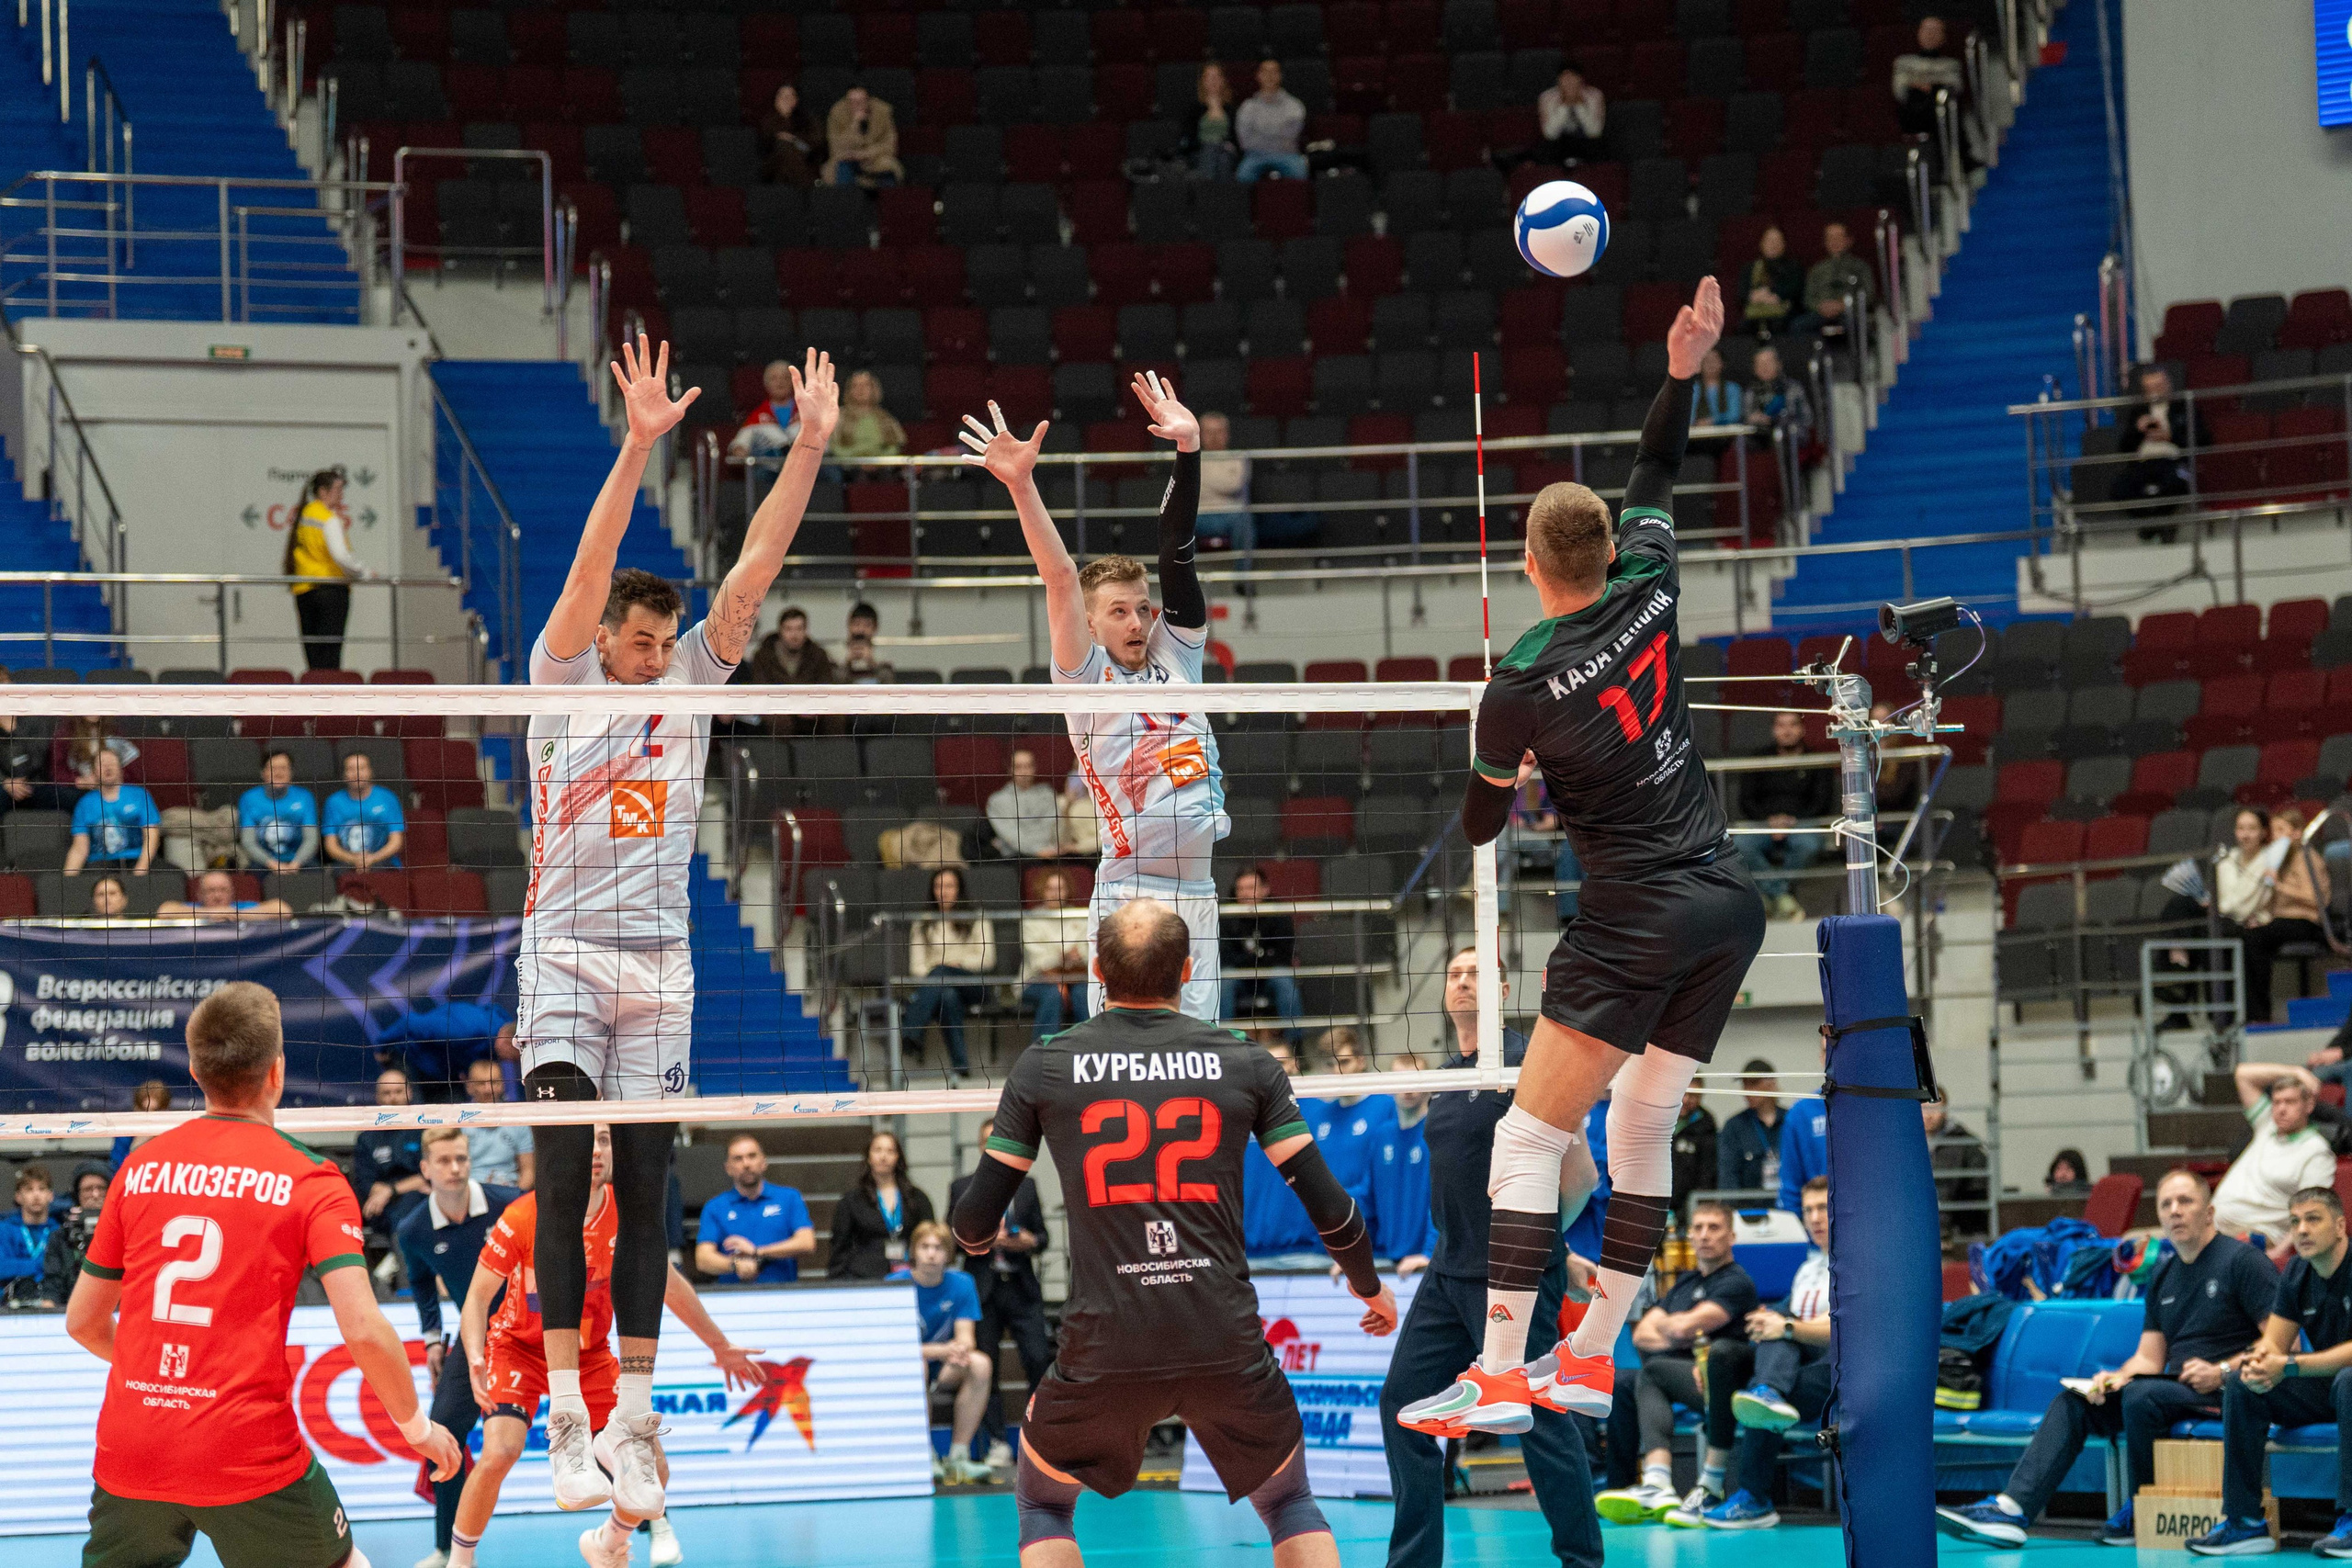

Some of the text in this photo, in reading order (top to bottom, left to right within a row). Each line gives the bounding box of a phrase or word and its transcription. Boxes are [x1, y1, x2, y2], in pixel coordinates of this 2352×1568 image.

[1597, 630, 1669, 744] 17
[1654, 759, 1685, 785] ОБЛАСТЬ
[25, 1035, 162, 1062] волейбола
[534, 1037, 560, 1049] ZASPORT
[1072, 1052, 1223, 1084] КУРБАНОВ
[1079, 1097, 1222, 1208] 22
[124, 1161, 293, 1206] МЕЛКОЗЕРОВ
[151, 1214, 224, 1328] 2
[1116, 1258, 1212, 1275] НОВОСИБИРСКАЯ
[1140, 1274, 1193, 1286] ОБЛАСТЬ
[125, 1380, 217, 1399] НОВОСИБИРСКАЯ
[509, 1371, 522, 1388] 7
[142, 1397, 191, 1411] ОБЛАСТЬ
[333, 1506, 349, 1539] 2
[2155, 1514, 2217, 1538] DARPO
